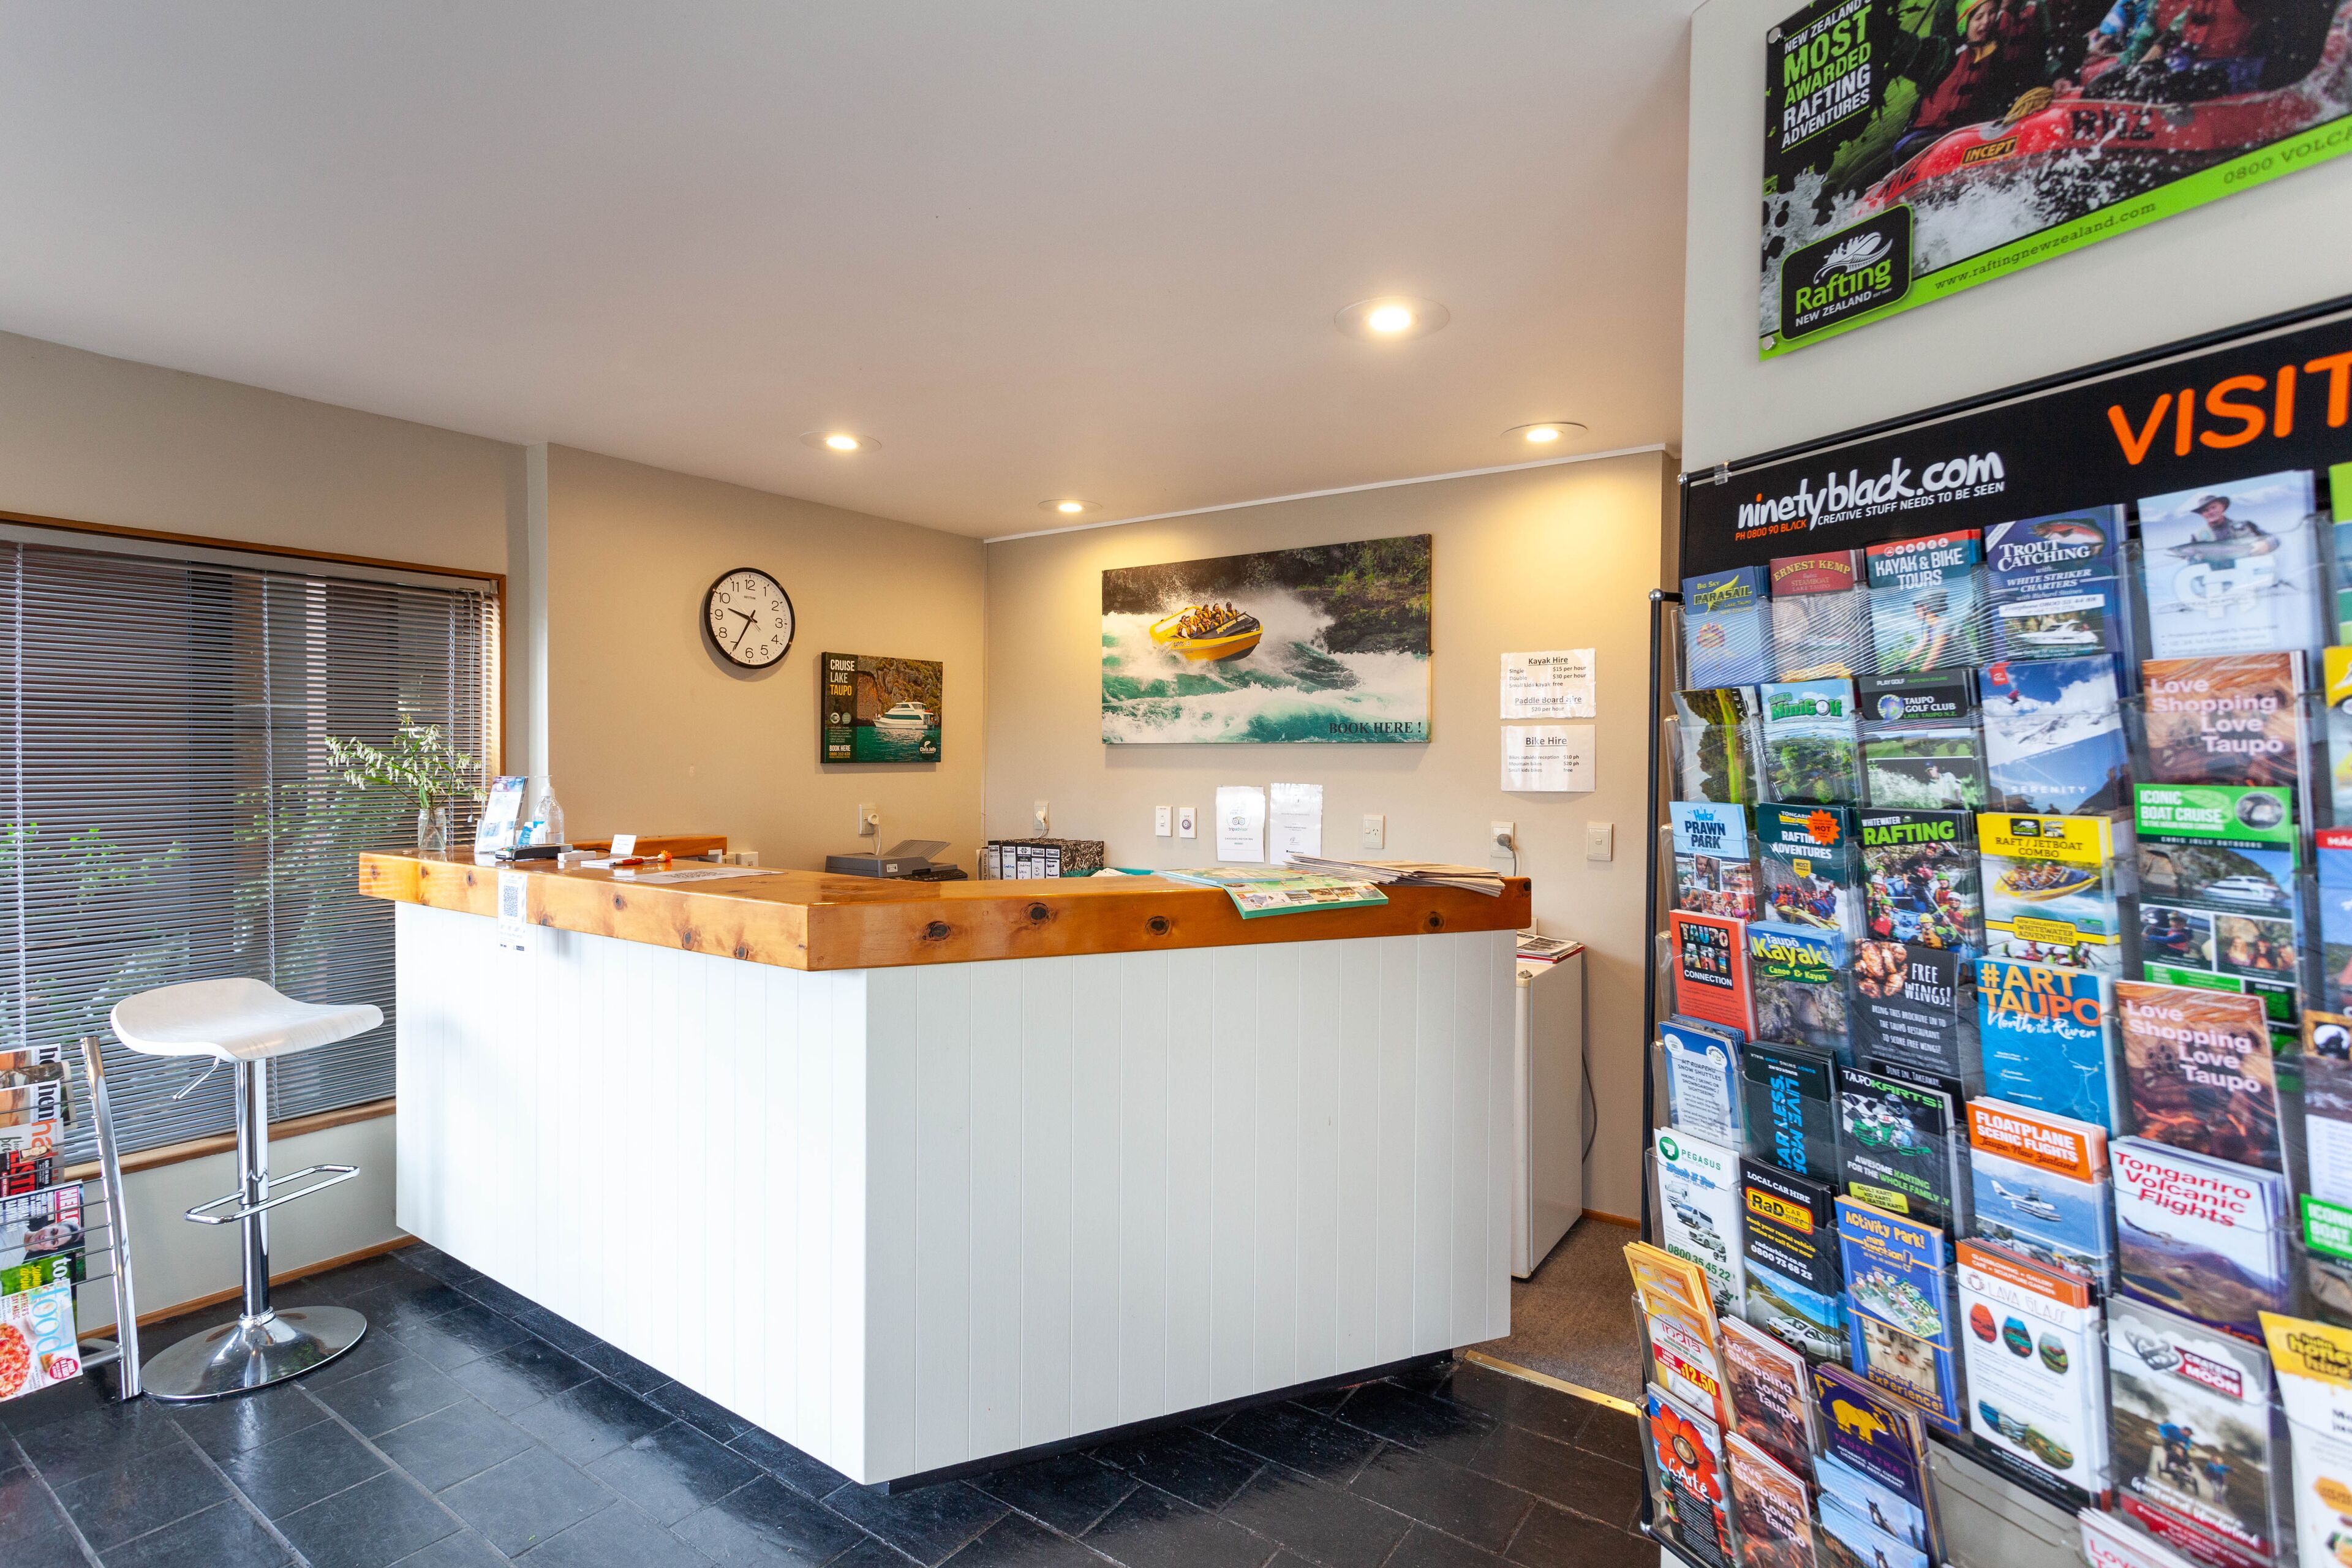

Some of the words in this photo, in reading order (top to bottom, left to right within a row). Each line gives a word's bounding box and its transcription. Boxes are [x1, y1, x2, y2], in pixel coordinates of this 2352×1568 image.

[1784, 4, 1872, 87] MOST
[1785, 30, 1807, 54] NEW
[1784, 42, 1871, 108] AWARDED
[1784, 64, 1871, 131] RAFTING
[1782, 89, 1871, 148] ADVENTURES
[1965, 140, 2015, 161] INCEPT
[2223, 157, 2273, 184] 0800
[1935, 201, 2156, 290] www.raftingnewzealand.com
[1796, 259, 1891, 314] Rafting
[1795, 311, 1819, 326] NEW
[1822, 292, 1872, 317] ZEALAND
[1738, 452, 2005, 531] ninetyblack.com
[1817, 508, 1863, 526] CREATIVE
[1865, 502, 1898, 516] STUFF
[1899, 496, 1934, 511] NEEDS
[1937, 492, 1951, 503] TO
[1955, 488, 1971, 500] BE
[1973, 481, 2005, 497] SEEN
[1735, 532, 1746, 541] PH
[1747, 527, 1767, 540] 0800
[1768, 524, 1779, 535] 90
[1780, 518, 1807, 533] BLACK
[1997, 545, 2091, 572] CATCHING
[1999, 539, 2059, 558] TROUT
[1774, 560, 1815, 582] ERNEST
[1819, 559, 1852, 575] KEMP
[1875, 554, 1917, 577] KAYAK
[1918, 555, 1929, 568] &
[1932, 548, 1965, 566] BIKE
[731, 581, 740, 592] 11
[744, 579, 756, 591] 12
[1897, 569, 1943, 590] TOURS
[718, 592, 731, 604] 10
[771, 600, 780, 612] 2
[1694, 585, 1752, 605] PARASAIL
[714, 609, 723, 620] 9
[775, 617, 783, 629] 3
[718, 627, 728, 638] 8
[771, 634, 779, 645] 4
[745, 647, 754, 658] 6
[760, 645, 769, 655] 5
[1528, 657, 1551, 665] Kayak
[830, 659, 855, 671] CRUISE
[830, 671, 848, 684] LAKE
[2150, 677, 2209, 694] Love
[830, 684, 853, 696] TAUPO
[1904, 696, 1935, 705] TAUPO
[1905, 704, 1929, 713] GOLF
[1931, 703, 1956, 711] CLUB
[2151, 695, 2278, 716] Shopping
[1329, 722, 1368, 734] BOOK
[1373, 721, 1413, 734] HERE
[2201, 716, 2263, 733] Love
[1526, 737, 1545, 745] Bike
[1548, 736, 1567, 745] Hire
[2010, 785, 2087, 795] SERENITY
[2140, 790, 2182, 804] ICONIC
[1694, 809, 1715, 822] Huka
[1861, 816, 1901, 827] WHITEWATER
[2141, 806, 2173, 820] BOAT
[2176, 808, 2223, 824] CRUISE
[1684, 820, 1726, 836] PRAWN
[1863, 820, 1956, 846] RAFTING
[1691, 834, 1721, 850] PARK
[1772, 842, 1833, 859] ADVENTURES
[1996, 837, 2023, 847] RAFT
[2033, 839, 2084, 851] JETBOAT
[2018, 847, 2060, 858] COMBO
[1752, 935, 1826, 968] Kayak
[1763, 933, 1800, 949] Taupō
[1684, 943, 1730, 973] ART
[1684, 969, 1733, 987] CONNECTION
[1768, 966, 1790, 976] Canoe
[1804, 970, 1828, 982] Kayak
[1912, 962, 1939, 984] FREE
[1981, 963, 2078, 997] #ART
[1904, 981, 1951, 1008] WINGS!
[1978, 987, 2101, 1027] TAUPO
[2126, 1000, 2184, 1022] Love
[1987, 1010, 2034, 1035] North
[2051, 1018, 2097, 1040] River
[2129, 1019, 2254, 1054] Shopping
[2178, 1042, 2241, 1070] Love
[1678, 1064, 1694, 1073] SNOW
[1694, 1068, 1722, 1082] SHUTTLES
[1975, 1110, 2076, 1152] FLOATPLANE
[1977, 1125, 2022, 1148] SCENIC
[2023, 1137, 2079, 1163] FLIGHTS
[1681, 1148, 1722, 1171] PEGASUS
[1847, 1161, 1861, 1174] FOR
[1863, 1166, 1879, 1180] THE
[1879, 1174, 1907, 1193] WHOLE
[1855, 1156, 1894, 1177] AWESOME
[1894, 1170, 1931, 1190] KARTING
[2114, 1152, 2252, 1200] Tongariro
[1747, 1171, 1773, 1188] LOCAL
[1773, 1182, 1790, 1195] CAR
[1789, 1189, 1811, 1204] HIRE
[2125, 1170, 2247, 1214] Volcanic
[1752, 1194, 1785, 1218] RaD
[1785, 1206, 1801, 1218] CAR
[2139, 1188, 2236, 1227] Flights
[1785, 1214, 1806, 1227] HIRE
[1668, 1243, 1692, 1262] 0800
[1705, 1262, 1717, 1275] 45
[1719, 1268, 1731, 1282] 22
[1751, 1244, 1775, 1262] 0800
[1787, 1262, 1801, 1275] 68
[1755, 1240, 1807, 1270] radcarhire.co.nz
[1988, 1281, 2020, 1306] LAVA
[31, 1285, 75, 1357] food
[1724, 1335, 1756, 1362] Love
[1681, 1362, 1717, 1397] $12.50
[1727, 1349, 1795, 1396] Shopping
[2185, 1363, 2241, 1395] MOON
[1754, 1376, 1787, 1404] Love
[1730, 1453, 1763, 1482] Love
[1733, 1466, 1803, 1520] Shopping
[1761, 1496, 1795, 1528] Love
